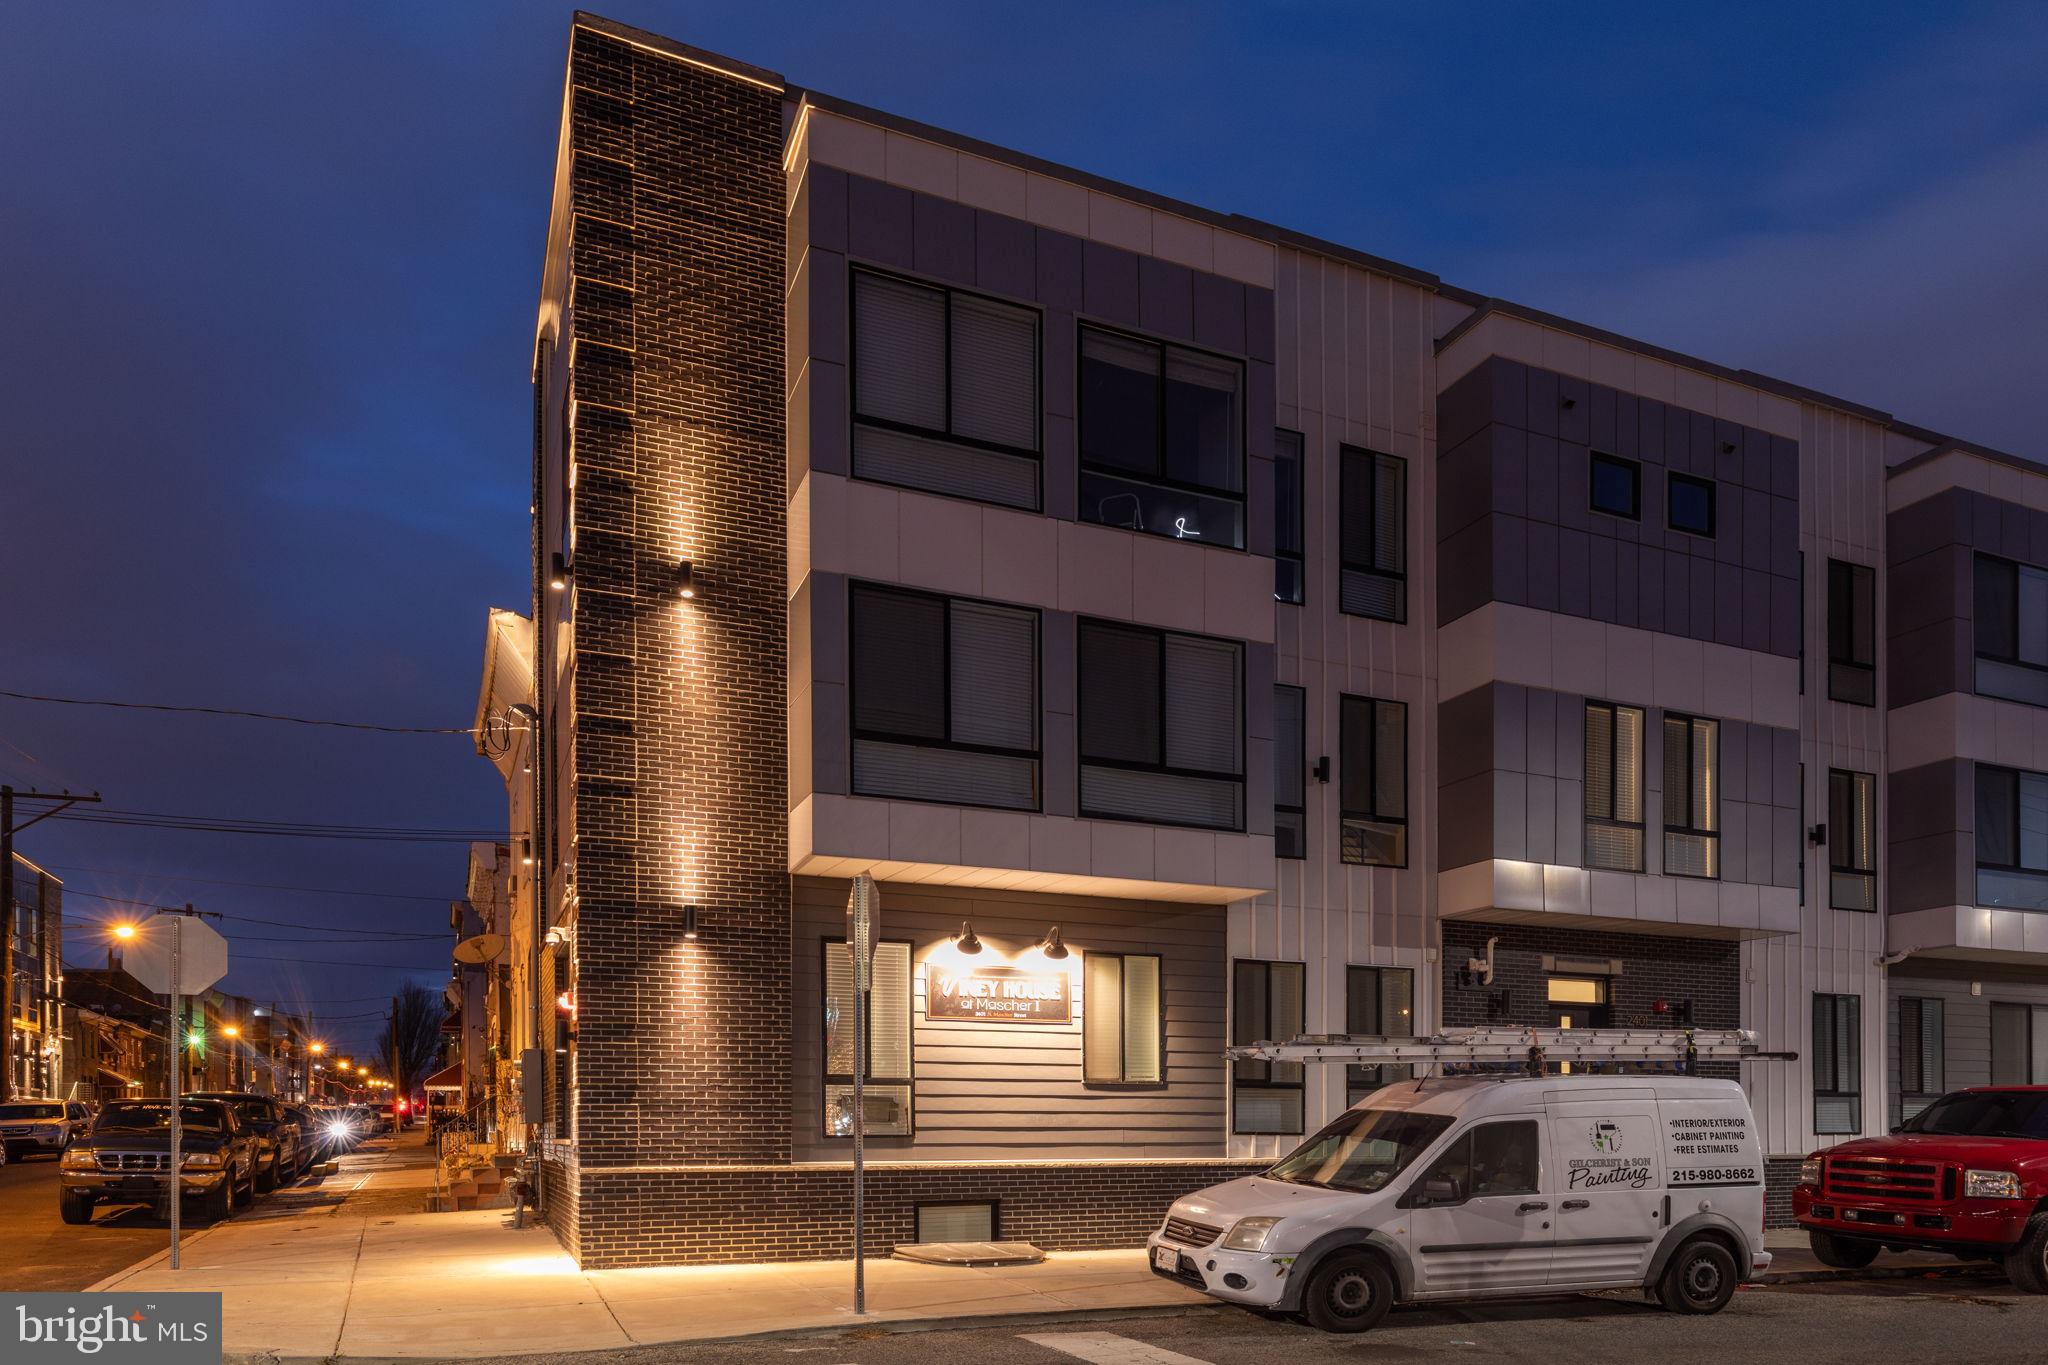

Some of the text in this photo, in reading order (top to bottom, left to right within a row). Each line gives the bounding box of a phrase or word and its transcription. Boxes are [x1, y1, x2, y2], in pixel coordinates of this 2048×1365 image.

[961, 999, 973, 1010] at
[976, 998, 1032, 1011] Mascher
[1672, 1118, 1746, 1128] INTERIOR/EXTERIOR
[1674, 1131, 1745, 1141] CABINET PAINTING
[1676, 1144, 1739, 1154] FREE ESTIMATES
[1568, 1157, 1651, 1168] GILCHRIST & SON
[1567, 1166, 1653, 1190] Painting
[1672, 1168, 1755, 1181] 215-980-8662
